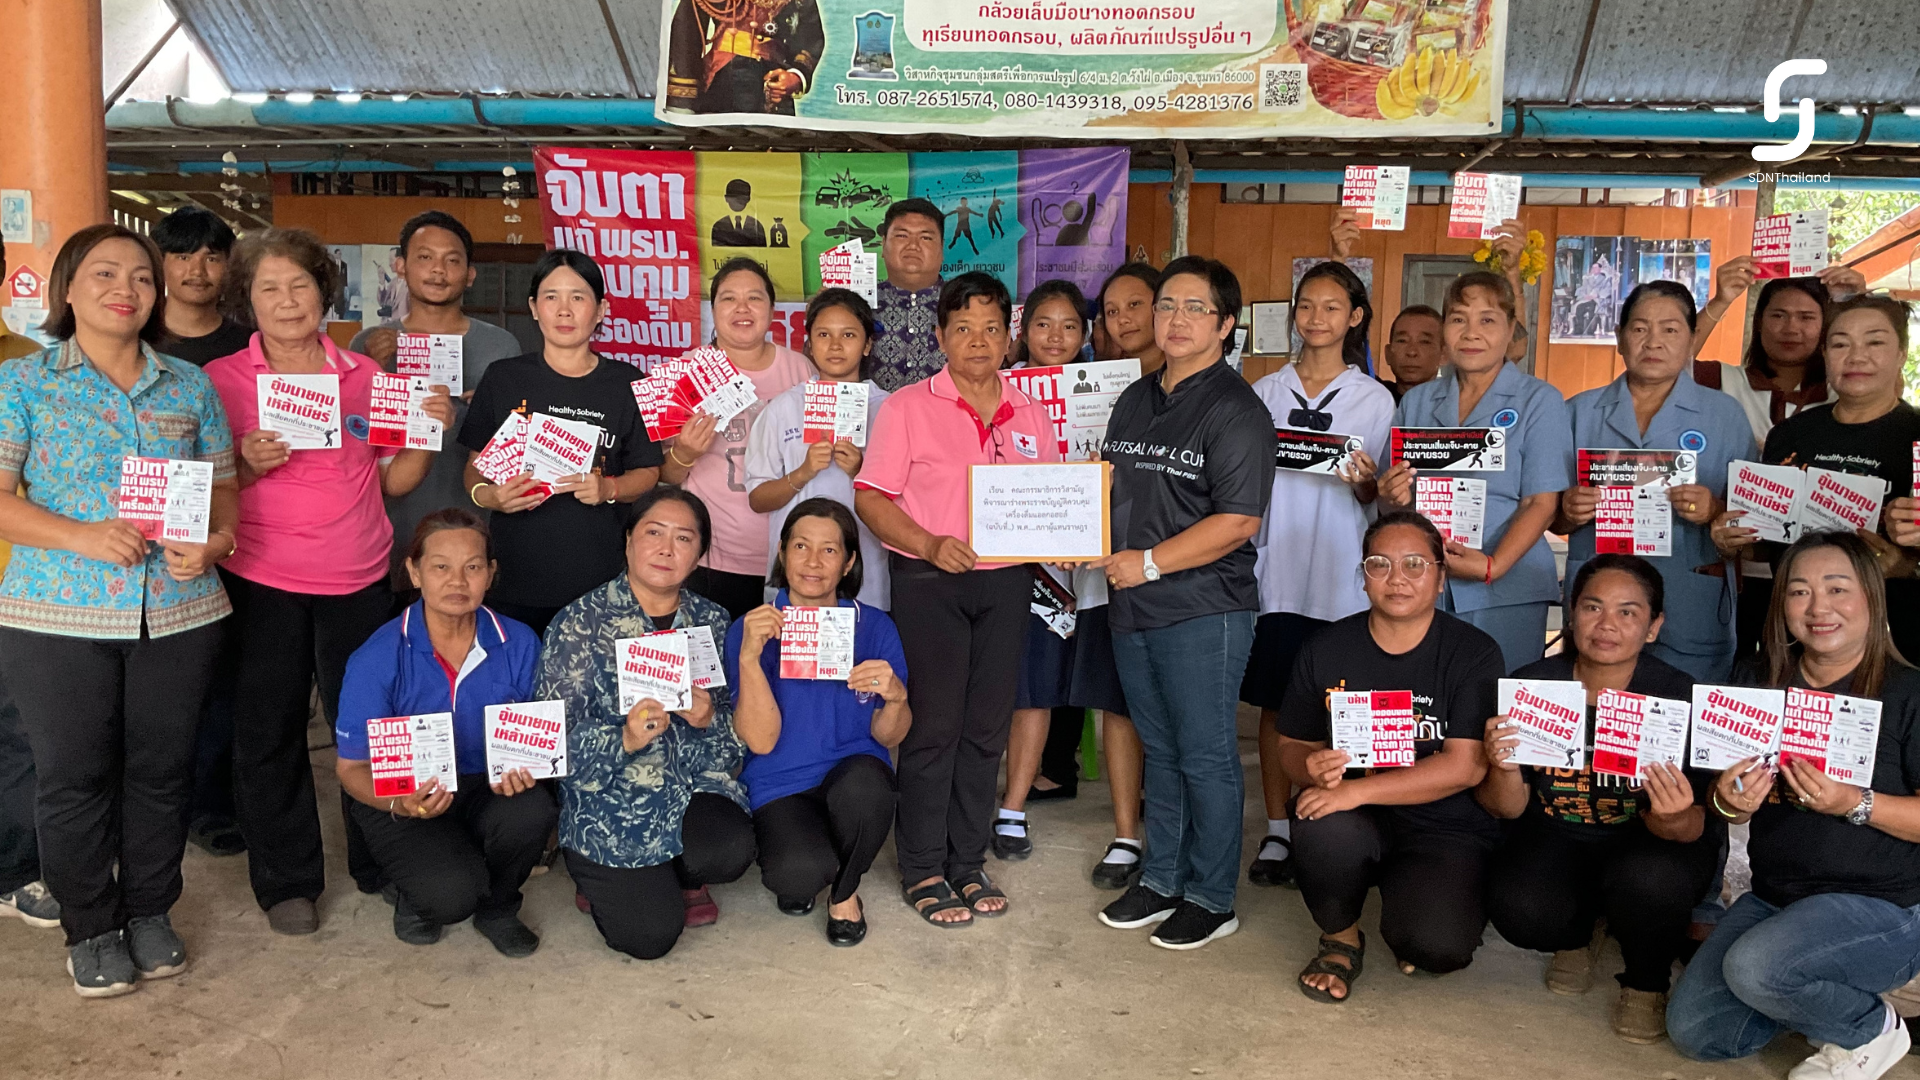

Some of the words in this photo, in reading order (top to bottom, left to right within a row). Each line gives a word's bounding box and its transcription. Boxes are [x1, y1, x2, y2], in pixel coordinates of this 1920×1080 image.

[978, 1, 1196, 20] กล้วยเล็บมือนางทอดกรอบ
[922, 24, 1062, 48] ทุเรียนทอดกรอบ,
[1080, 73, 1095, 83] 6/4
[1112, 73, 1118, 83] 2
[1155, 69, 1184, 83] อ.เมือง
[1187, 73, 1221, 87] จ.ชุมพร
[1225, 72, 1254, 83] 86000
[836, 86, 870, 105] โทร.
[878, 91, 998, 110] 087-2651574,
[1005, 93, 1127, 111] 080-1439318,
[1134, 95, 1253, 110] 095-4281376
[545, 154, 685, 220] จับตา
[553, 219, 596, 257] แก้
[600, 228, 690, 259] พรบ.
[271, 377, 335, 408] อุ้มนายทุน
[266, 396, 332, 423] เหล้าเบียร์
[549, 405, 576, 416] Healthy
[577, 406, 605, 420] Sobriety
[542, 418, 592, 453] อุ้มนายทุน
[1109, 441, 1145, 455] FUTSAL
[1278, 441, 1338, 454] ะชาชนเสี่ยงเจ็บ-ตาย
[534, 433, 586, 466] เหล้าเบียร์
[1276, 450, 1312, 460] นขายรวย
[1403, 451, 1450, 459] คนขายรวย
[1815, 454, 1846, 463] Healthy
[1846, 455, 1881, 468] Sobriety
[1167, 467, 1182, 476] Thai
[1590, 473, 1638, 481] คนขายรวย
[1739, 466, 1794, 499] อุ้มนายทุน
[1818, 473, 1877, 512] อุ้มนายทุน
[628, 641, 685, 668] อุ้มนายทุน
[624, 661, 682, 684] เหล้าเบียร์
[1514, 686, 1580, 723] อุ้มนายทุน
[1707, 688, 1779, 726] อุ้มนายทุน
[498, 707, 561, 735] อุ้มนายทุน
[1508, 706, 1576, 740] เหล้าเบียร์
[1700, 709, 1774, 744] เหล้าเบียร์
[494, 728, 558, 751] เหล้าเบียร์
